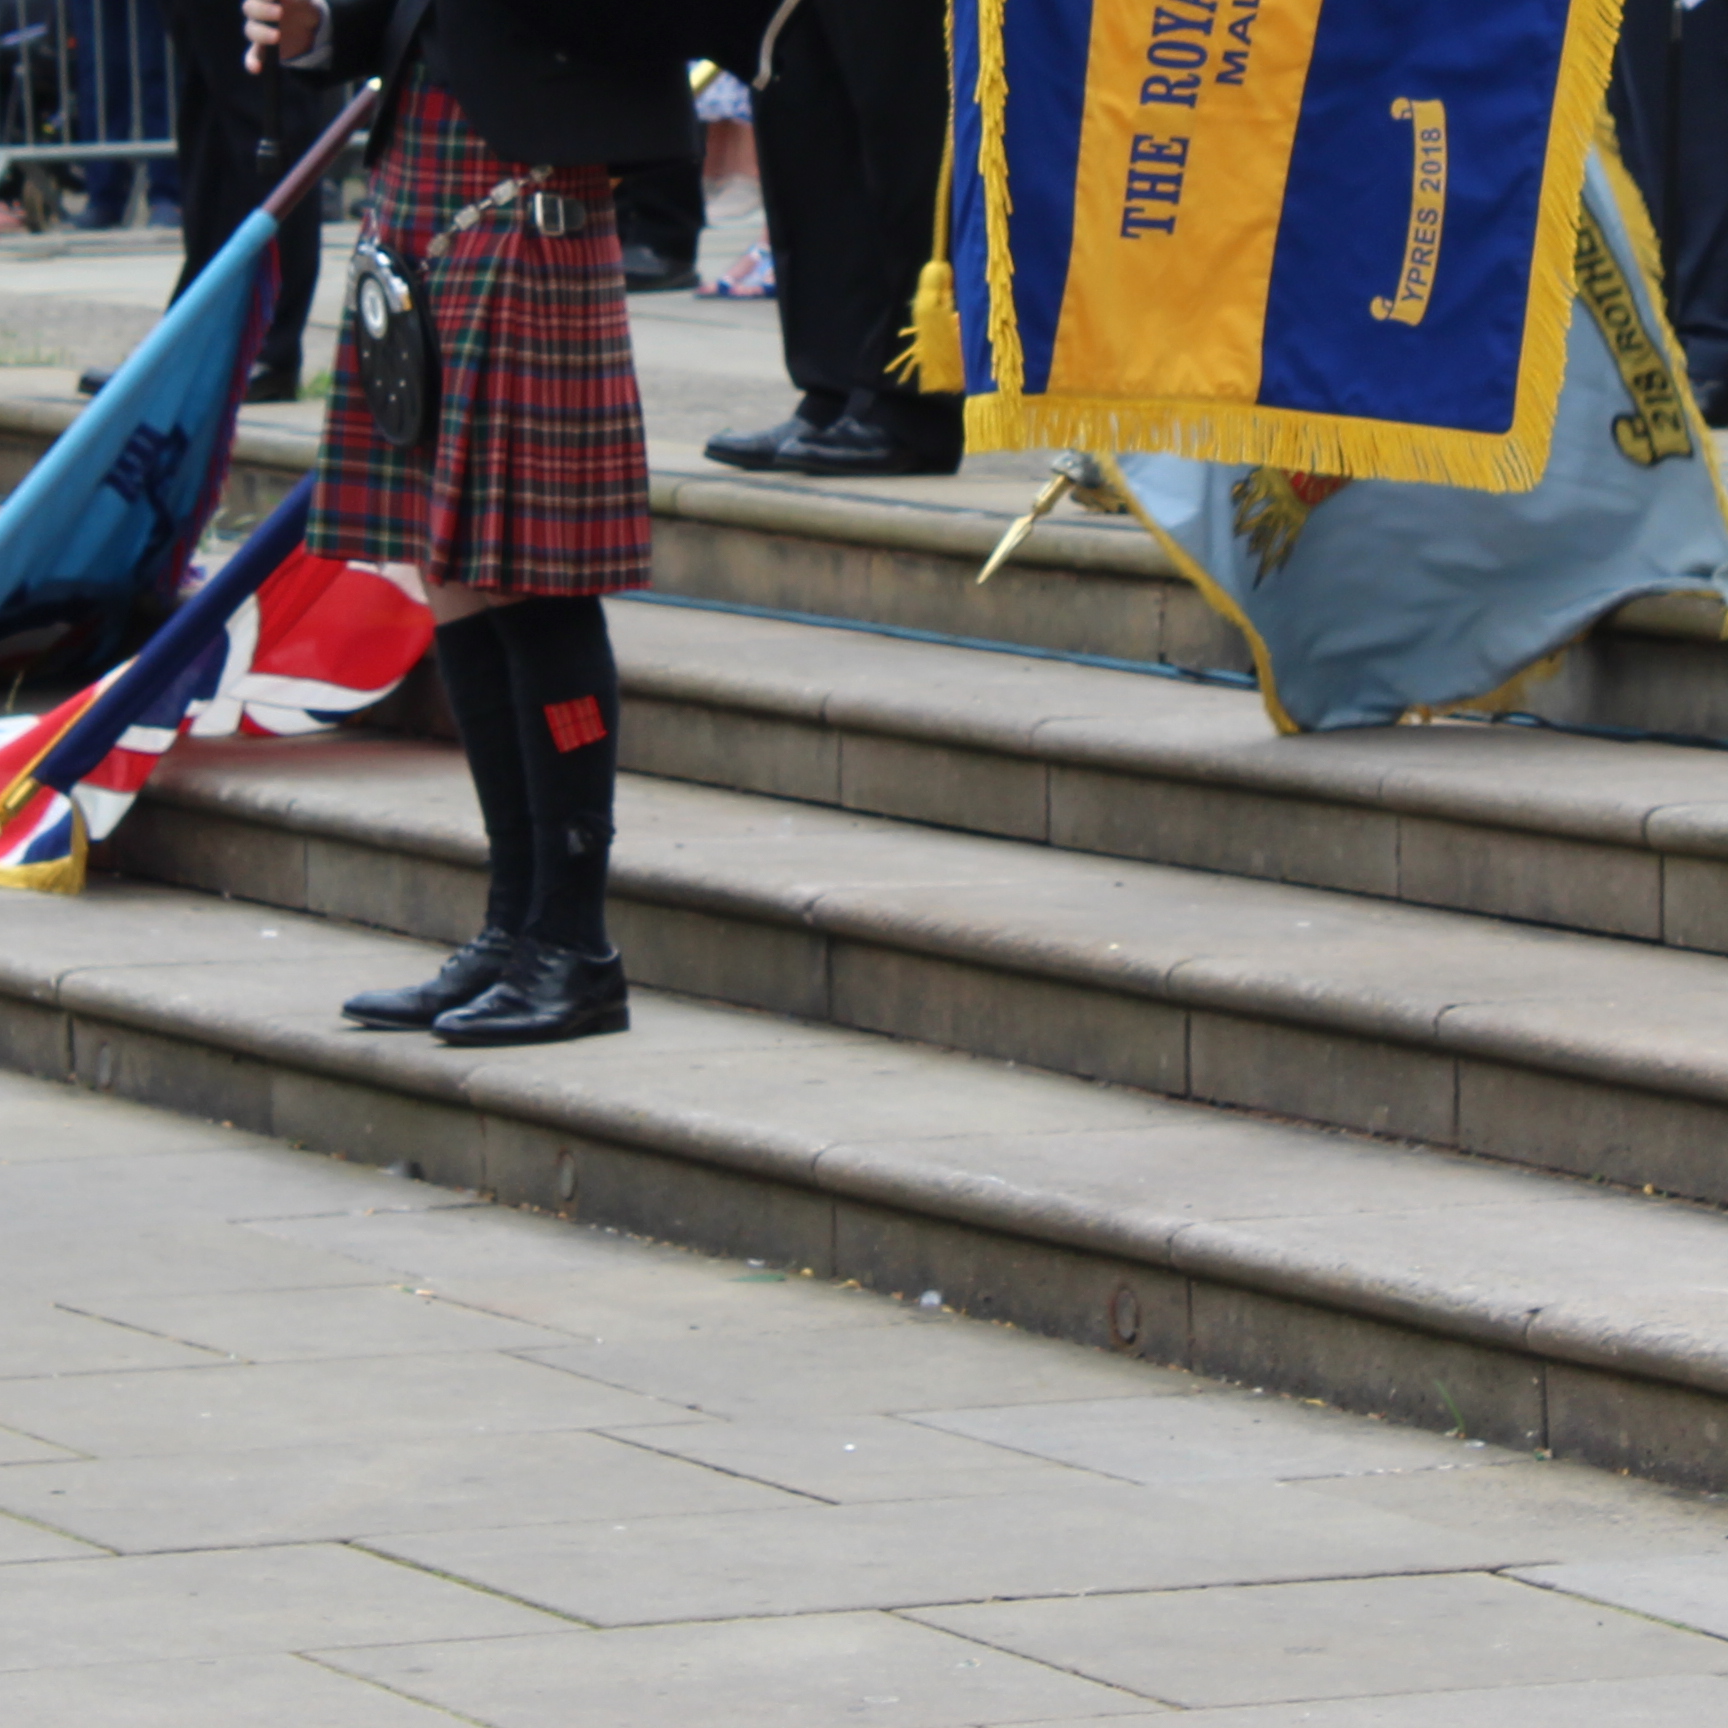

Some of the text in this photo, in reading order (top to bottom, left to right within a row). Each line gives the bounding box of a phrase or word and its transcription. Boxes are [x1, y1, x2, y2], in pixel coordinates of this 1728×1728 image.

[1120, 134, 1190, 240] THE
[1400, 126, 1443, 302] YPRES 2018
